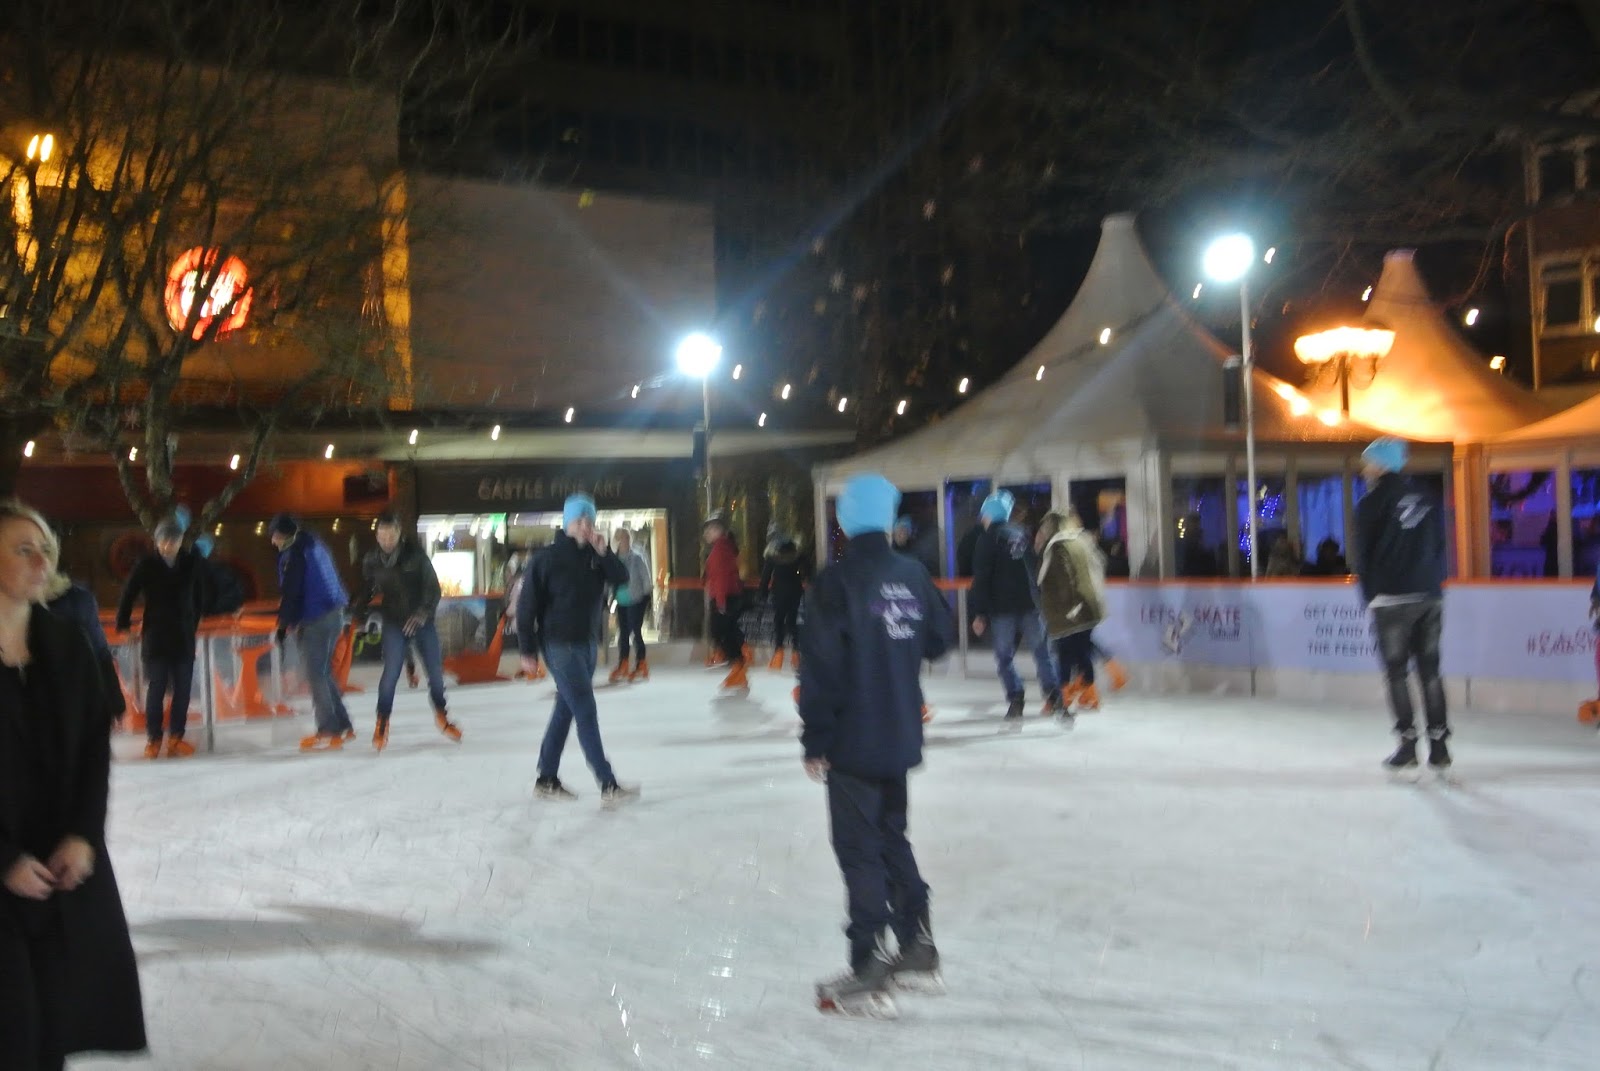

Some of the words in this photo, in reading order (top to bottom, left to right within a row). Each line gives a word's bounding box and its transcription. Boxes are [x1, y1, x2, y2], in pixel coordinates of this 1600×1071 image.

[478, 476, 545, 500] CASTLE
[551, 475, 588, 497] FINE
[593, 475, 626, 498] ART
[1194, 606, 1240, 624] SKATE
[1303, 605, 1326, 620] GET
[1316, 624, 1333, 637] ON
[1338, 624, 1363, 638] AND
[1307, 641, 1330, 656] THE
[1334, 642, 1379, 657] FESTIV
